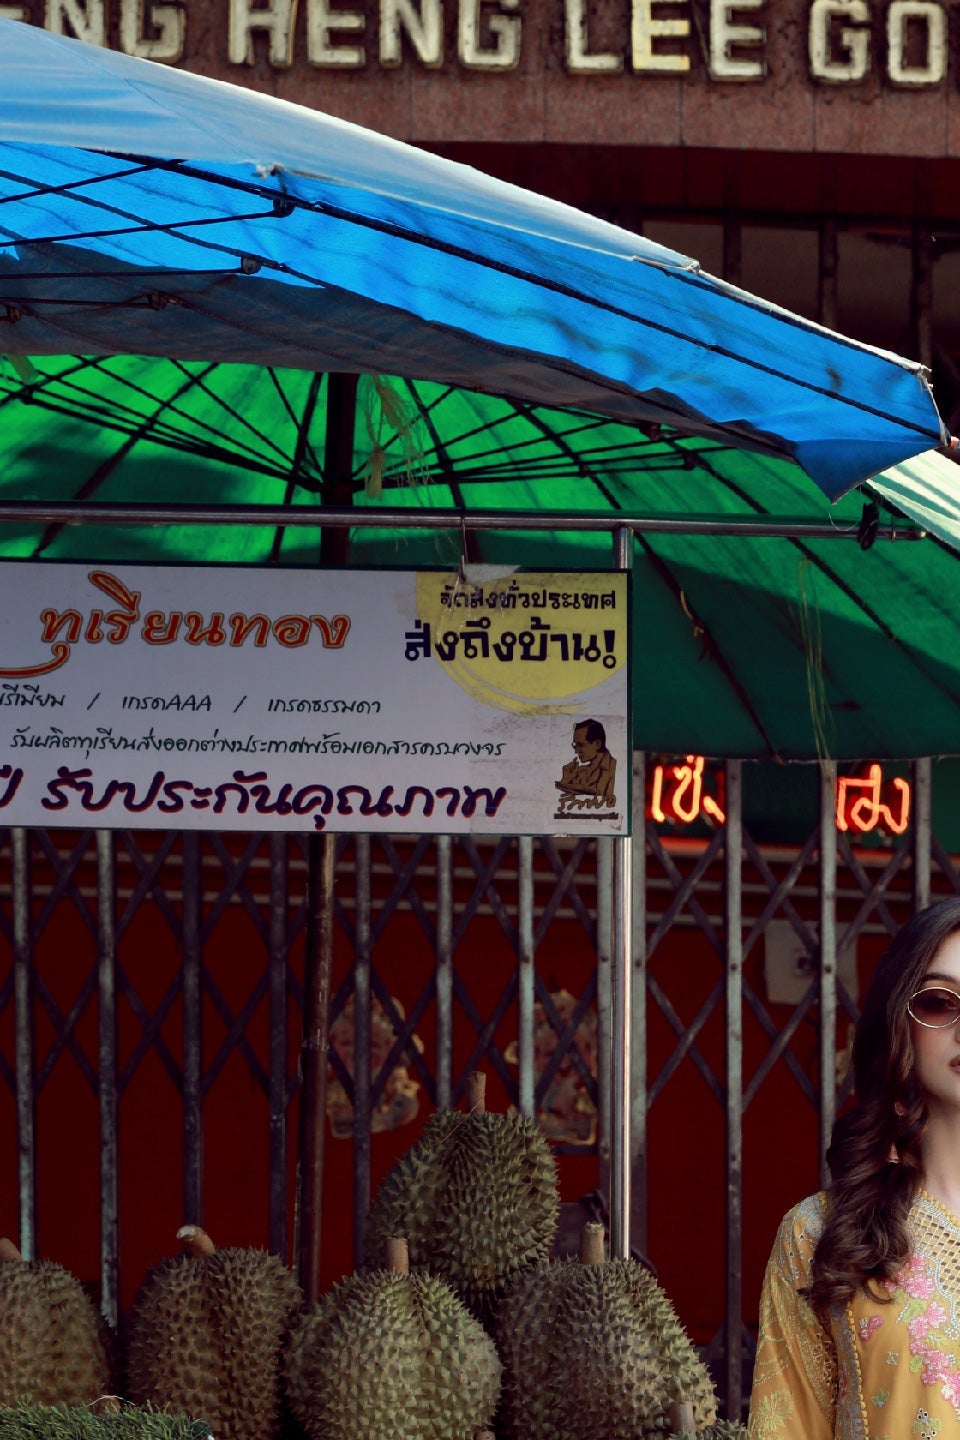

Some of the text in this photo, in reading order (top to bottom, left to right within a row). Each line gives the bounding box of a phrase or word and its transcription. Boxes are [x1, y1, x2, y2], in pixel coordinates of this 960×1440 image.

[0, 0, 186, 62] NG
[228, 0, 522, 70] HENG
[566, 0, 768, 81] LEE
[0, 571, 351, 678] ทุเรียนทอง
[404, 616, 617, 669] ส่งถึงบ้าน!
[0, 684, 66, 708] รีเมียม
[41, 765, 508, 830] รับประกันคุณภาพ
